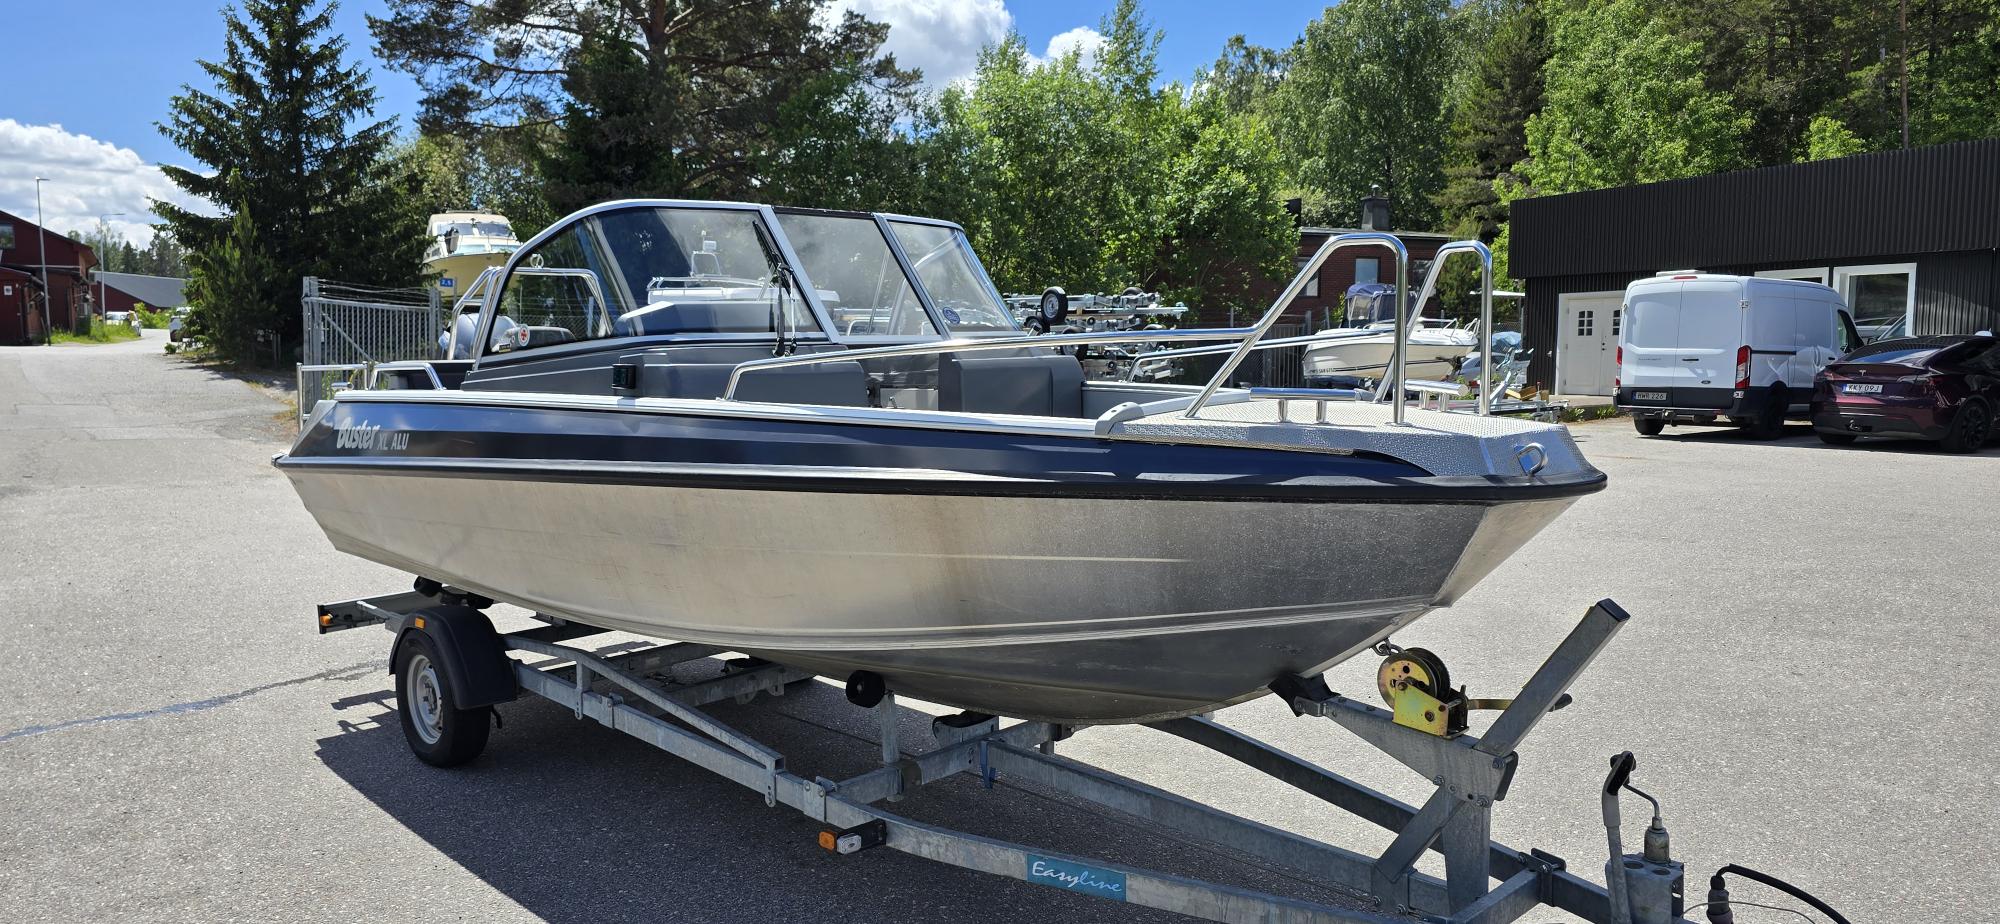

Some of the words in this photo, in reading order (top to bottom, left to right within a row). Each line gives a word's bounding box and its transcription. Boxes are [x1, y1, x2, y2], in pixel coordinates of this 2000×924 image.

[1651, 392, 1664, 400] 226
[336, 416, 381, 449] Buster
[377, 433, 389, 451] XL
[391, 432, 410, 450] ALU
[1032, 861, 1122, 892] Easyline
